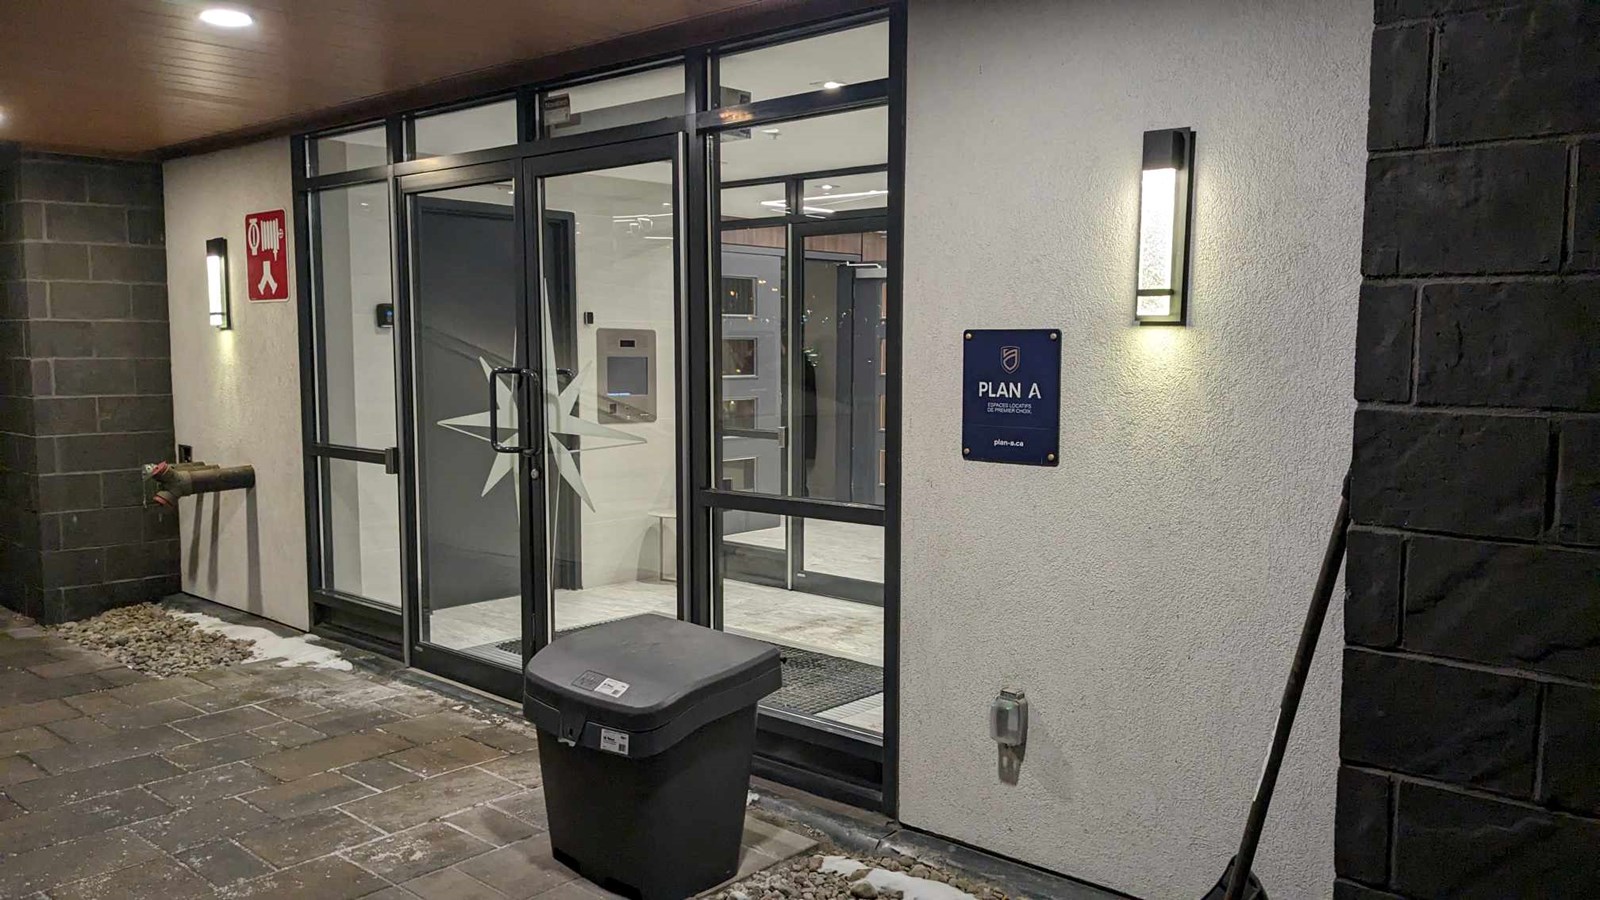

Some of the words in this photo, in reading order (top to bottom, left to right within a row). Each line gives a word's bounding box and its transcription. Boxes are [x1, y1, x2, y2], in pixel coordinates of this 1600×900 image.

[978, 381, 1021, 399] PLAN
[1028, 382, 1042, 399] A
[993, 438, 1024, 447] plan-a.ca
